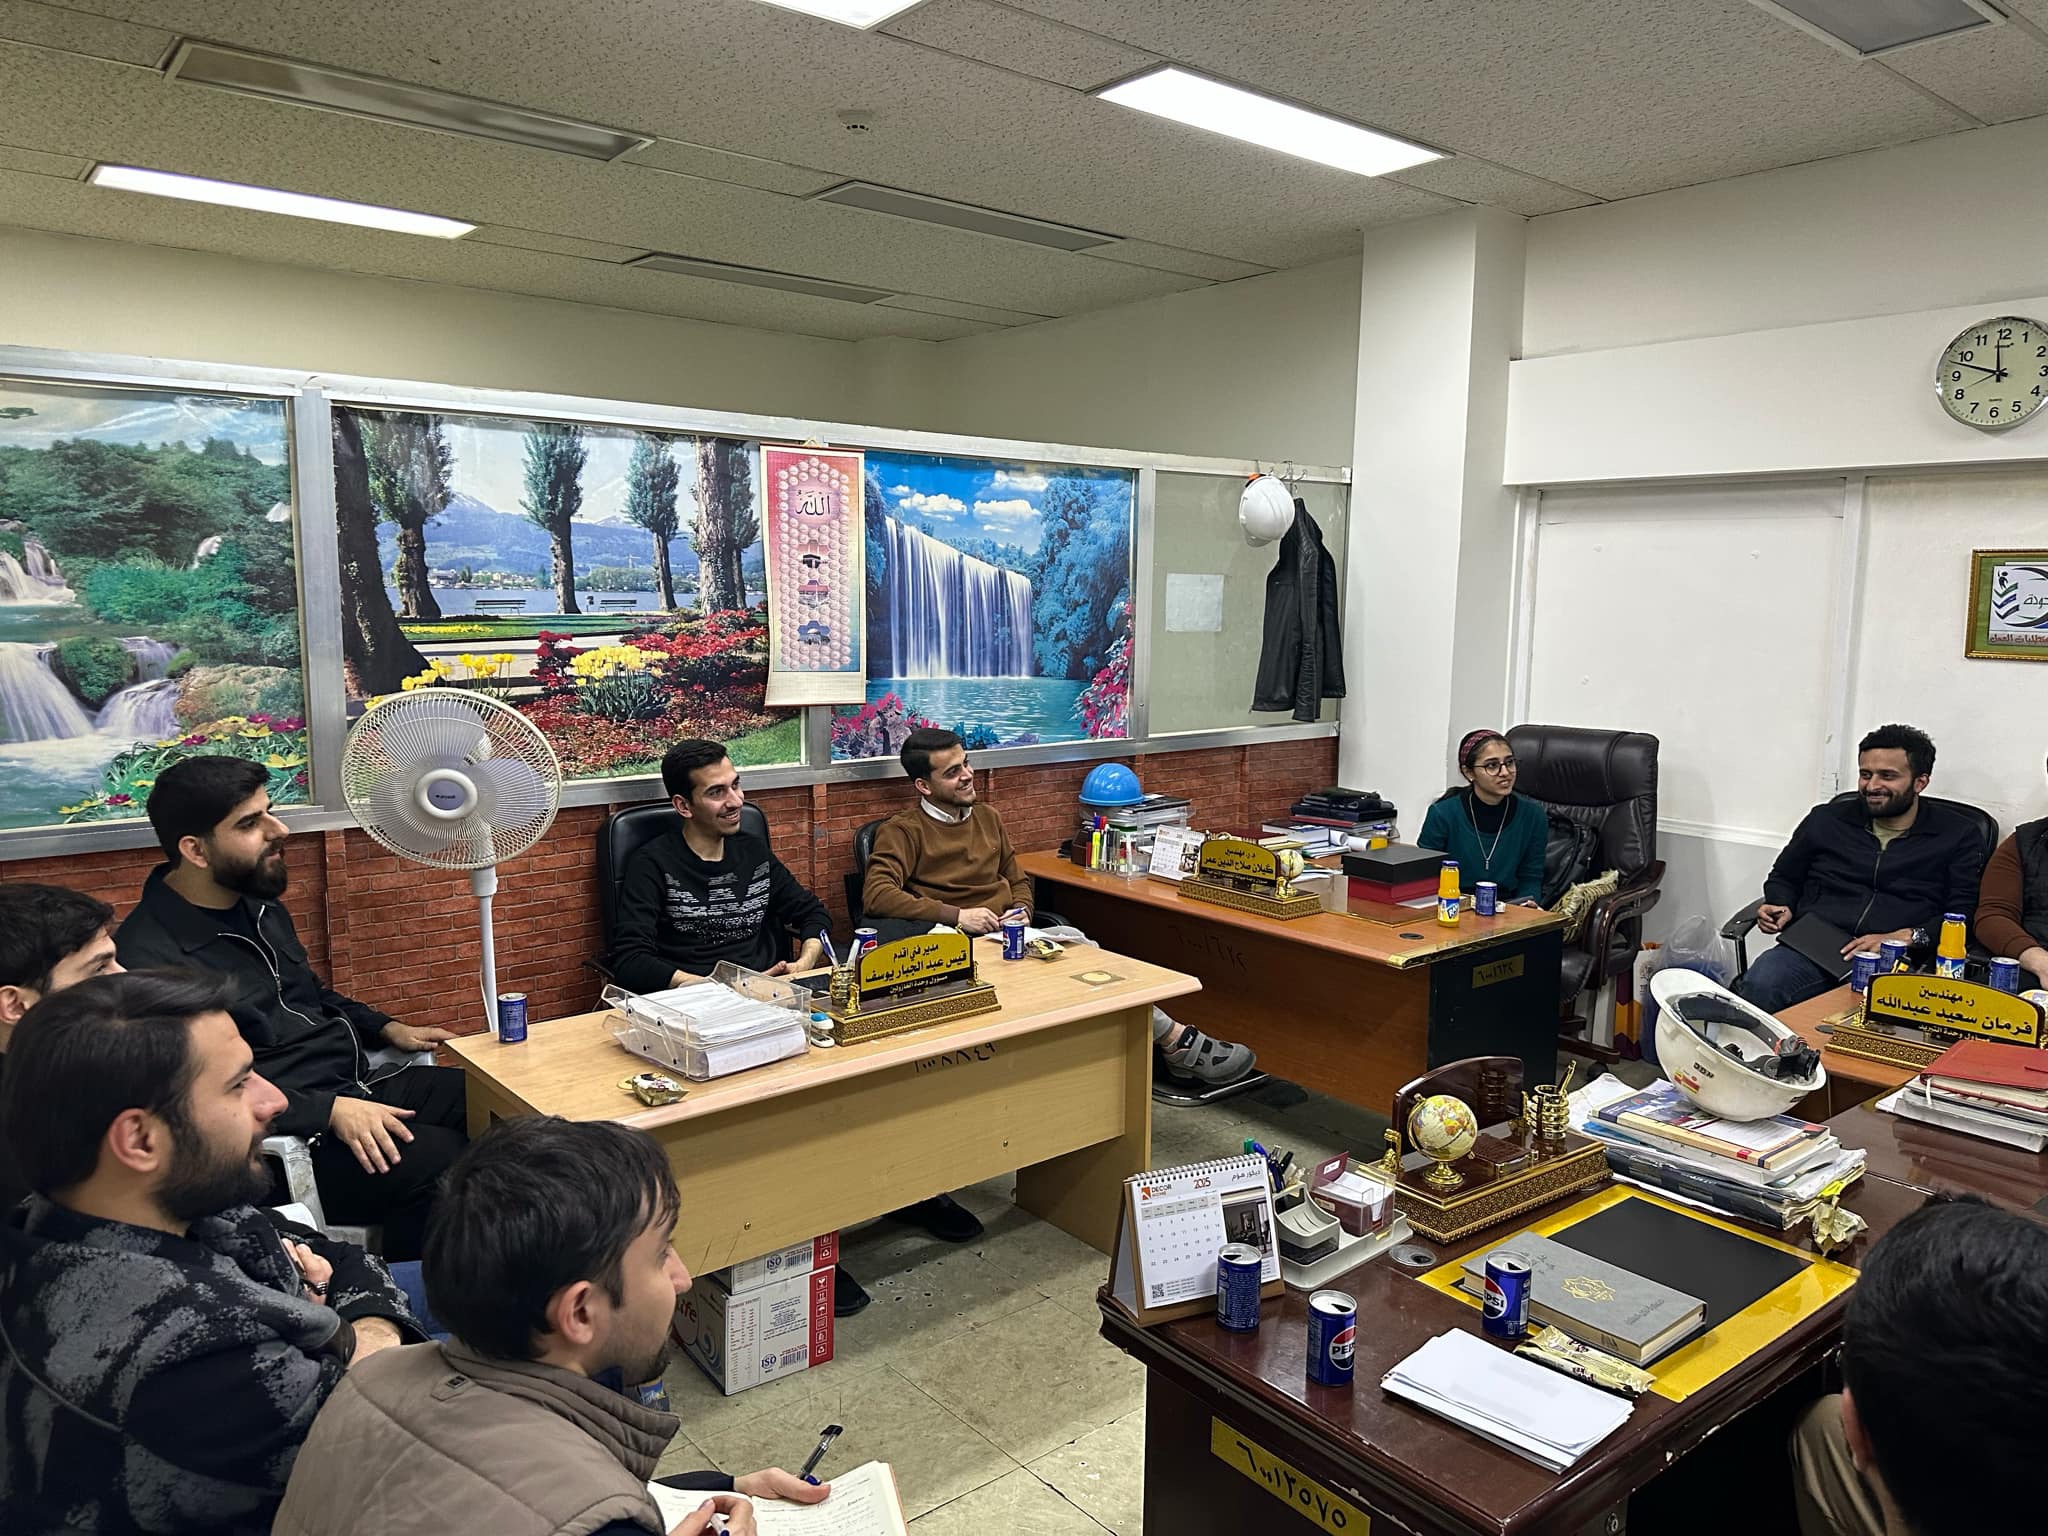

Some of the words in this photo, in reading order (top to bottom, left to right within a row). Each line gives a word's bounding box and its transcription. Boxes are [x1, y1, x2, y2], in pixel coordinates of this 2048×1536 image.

[1975, 334, 1988, 346] 11
[1997, 328, 2012, 340] 12
[2022, 331, 2028, 343] 1
[1958, 350, 1974, 362] 10
[2036, 345, 2046, 358] 2
[1951, 370, 1961, 382] 9
[2039, 365, 2048, 377] 3
[1954, 388, 1965, 400] 8
[2030, 385, 2040, 397] 4
[1970, 402, 1980, 414] 7
[1989, 407, 1999, 418] 6
[2011, 401, 2022, 413] 5
[922, 943, 939, 956] مدير
[925, 958, 943, 971] عبد
[945, 949, 968, 968] قيس
[896, 960, 924, 978] الجبار
[865, 969, 895, 983] يوسف
[1918, 984, 1963, 1004] مهندسين
[1936, 1007, 1977, 1024] سعيد
[1981, 1016, 2033, 1036] فرمان
[1151, 1184, 1172, 1193] DECOR
[766, 1256, 782, 1269] ISO
[1485, 1293, 1505, 1308] PSI
[1332, 1342, 1355, 1355] PEP
[761, 1355, 777, 1368] ISO
